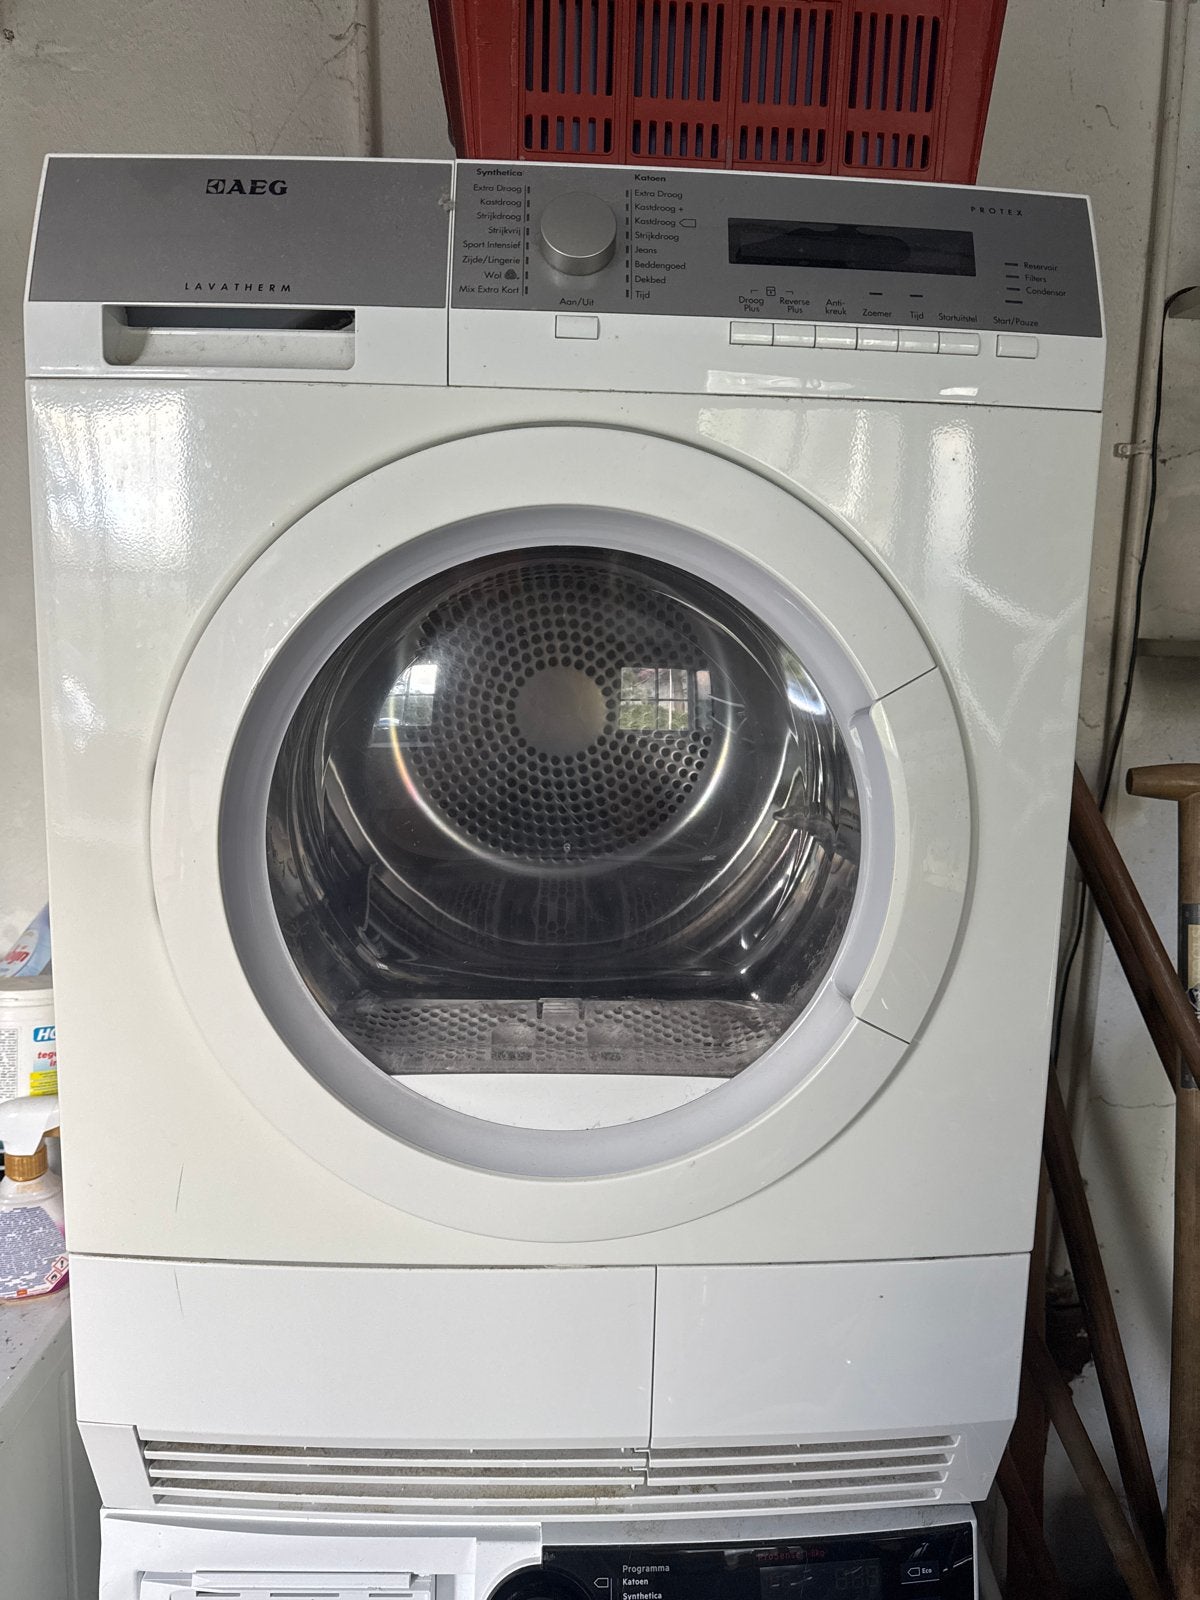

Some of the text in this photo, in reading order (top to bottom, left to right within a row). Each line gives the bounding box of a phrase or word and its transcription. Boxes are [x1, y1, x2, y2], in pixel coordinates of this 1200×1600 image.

[476, 168, 523, 177] Synthetica
[634, 174, 667, 182] Katoen
[226, 179, 288, 195] AEG
[496, 184, 522, 193] Droog
[634, 189, 683, 200] Extra Droog
[480, 198, 522, 207] Kastdroog
[634, 203, 676, 213] Kastdroog
[970, 206, 1023, 217] PROTEX
[476, 211, 522, 222] Strijkdroog
[634, 217, 676, 227] Kastdroog
[488, 226, 521, 236] Strijkvrij
[634, 231, 680, 242] Strijkdroog
[462, 240, 521, 250] Sport Intensief
[634, 246, 658, 254] Jeans
[462, 255, 521, 266] Zijde/Lingerie
[634, 260, 686, 271] Beddengoed
[1023, 261, 1058, 272] Reservoir
[483, 271, 502, 280] Wol
[634, 275, 666, 284] Dekbed
[1024, 274, 1047, 283] Filters
[185, 283, 291, 292] LAVATHERM
[458, 285, 519, 294] Mix Extra Kort
[1025, 286, 1067, 297] Condensor
[635, 290, 651, 300] Tijd
[559, 297, 595, 307] Aan/Uit
[738, 296, 765, 306] Droog
[779, 296, 811, 306] Reverse
[825, 299, 846, 307] Anti-
[744, 304, 760, 313] Plus
[787, 305, 803, 314] Plus
[825, 306, 847, 316] kreuk
[862, 309, 893, 318] Zoemer
[910, 311, 924, 321] Tijd
[938, 312, 978, 323] Startuitstel
[993, 316, 1039, 327] Start/Pauze
[622, 1565, 670, 1574] Programma
[921, 1567, 933, 1575] Eco
[622, 1578, 649, 1586] Katoen
[622, 1592, 662, 1600] Synthetica
